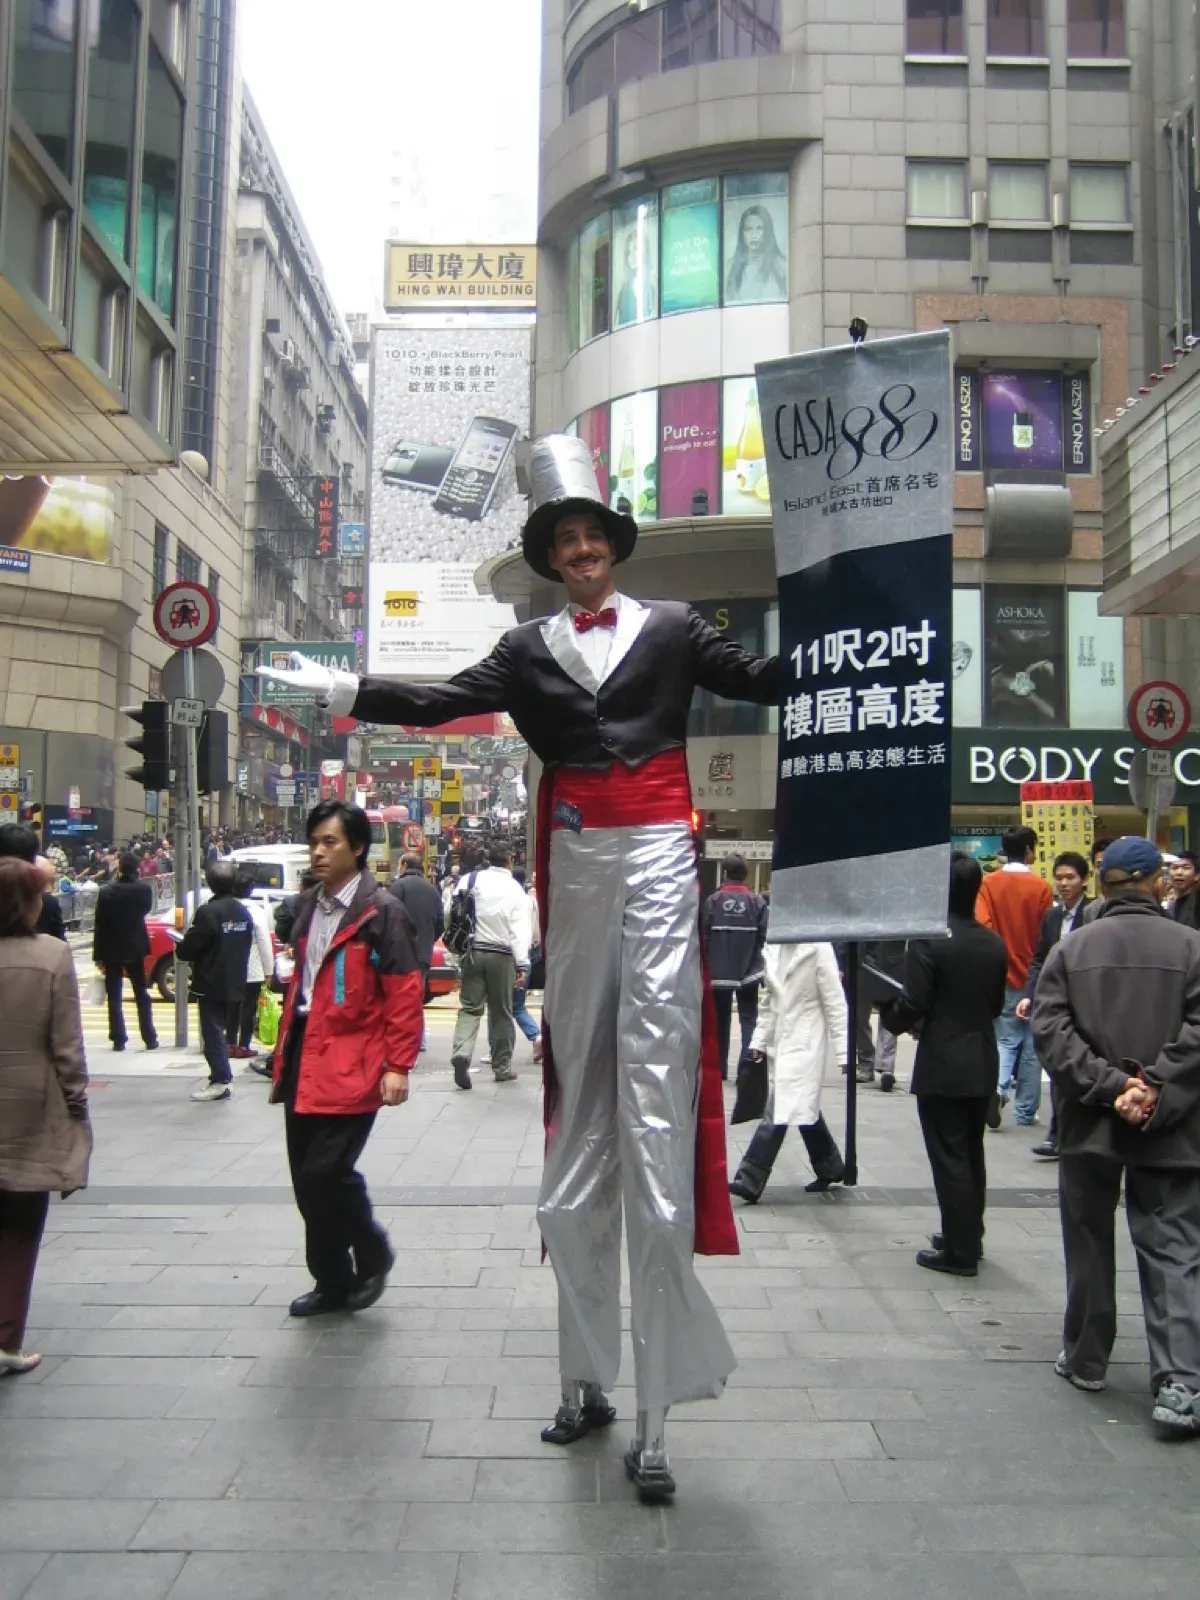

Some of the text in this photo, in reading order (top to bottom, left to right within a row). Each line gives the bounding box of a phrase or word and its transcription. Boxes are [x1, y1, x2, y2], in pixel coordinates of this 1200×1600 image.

[407, 252, 526, 280] 興瑋大廈
[397, 284, 533, 295] HING WAI BUILDING
[494, 350, 523, 358] Pearl
[775, 397, 837, 460] CASA
[961, 421, 972, 462] ERNO
[1071, 423, 1083, 465] ERNO
[784, 471, 939, 512] Island East 首席名宅
[996, 607, 1045, 618] ASHOKA
[791, 620, 937, 679] 11呎2吋
[783, 678, 945, 741] 樓層高度
[780, 743, 946, 778] 體驗港島高姿態生活
[970, 747, 1102, 784] BODY
